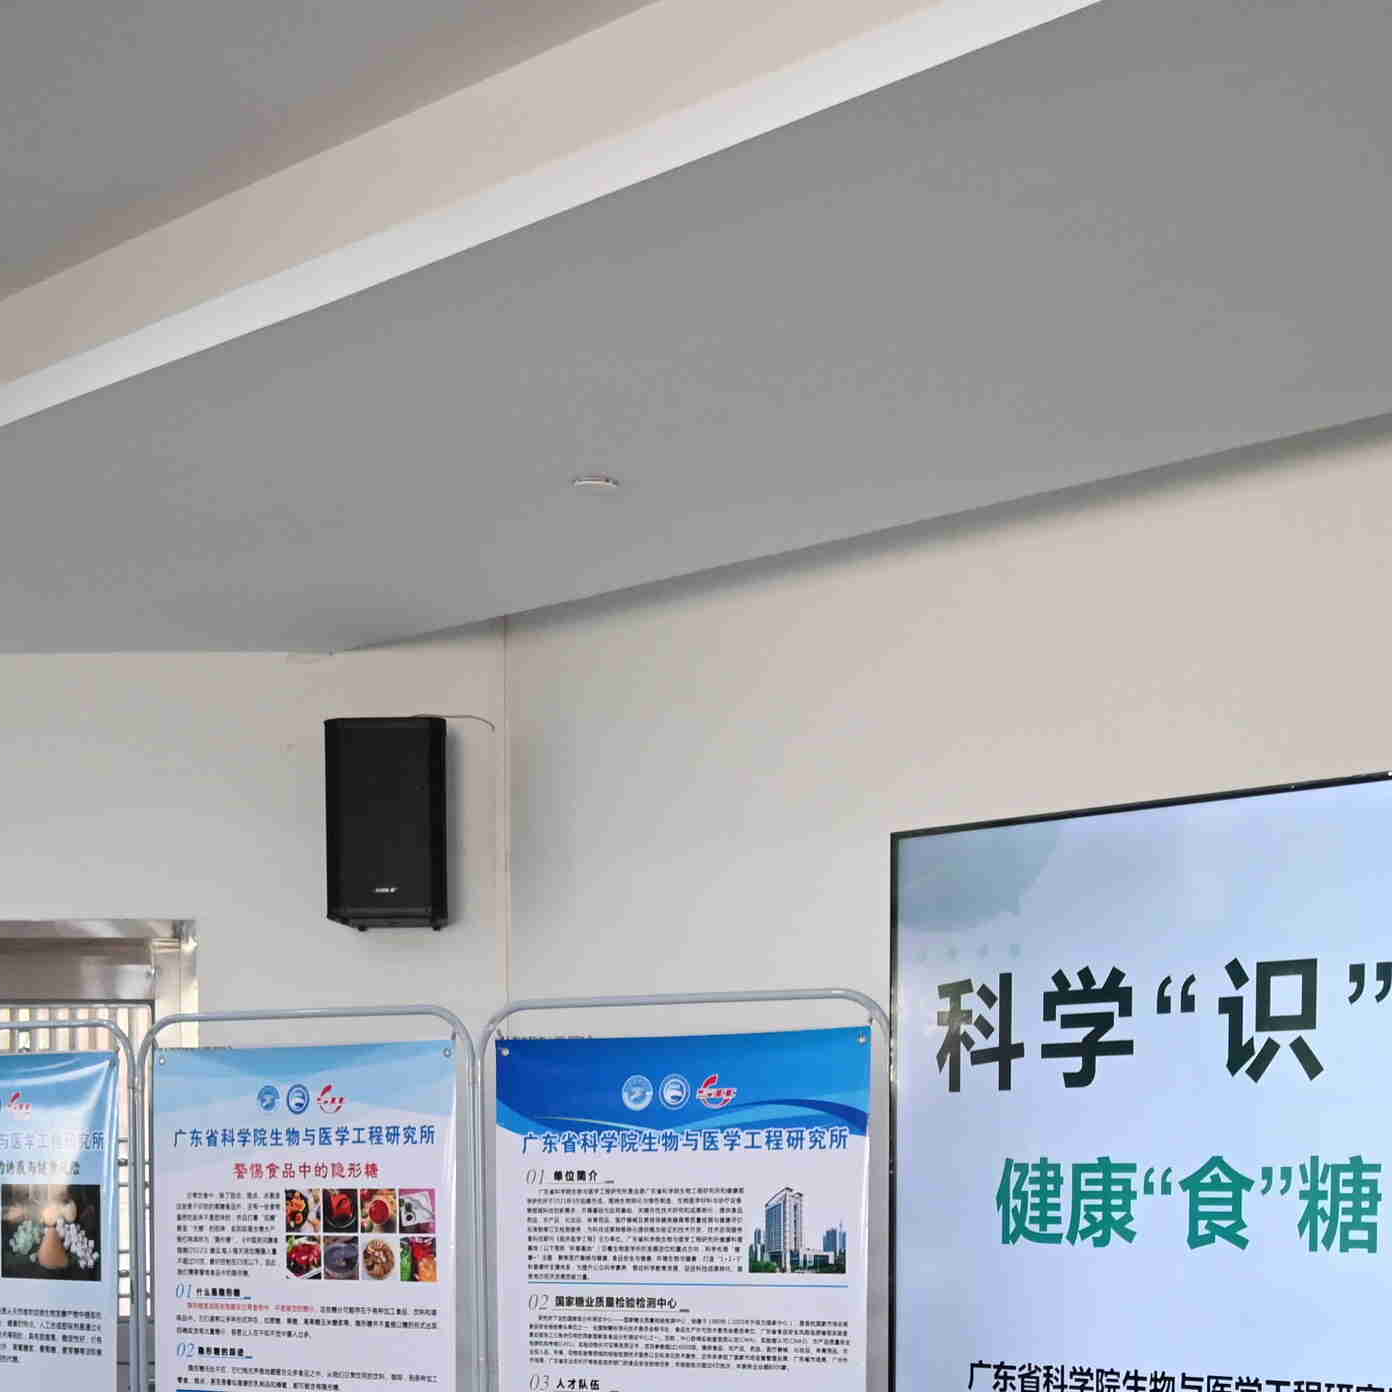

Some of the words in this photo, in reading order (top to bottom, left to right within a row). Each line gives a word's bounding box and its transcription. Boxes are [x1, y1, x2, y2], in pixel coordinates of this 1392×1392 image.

[173, 1124, 436, 1149] 广东省科学院生物与医学工程研究所
[521, 1126, 849, 1155] 广东省科学院生物与医学工程研究所
[555, 1377, 601, 1392] 人才队伍
